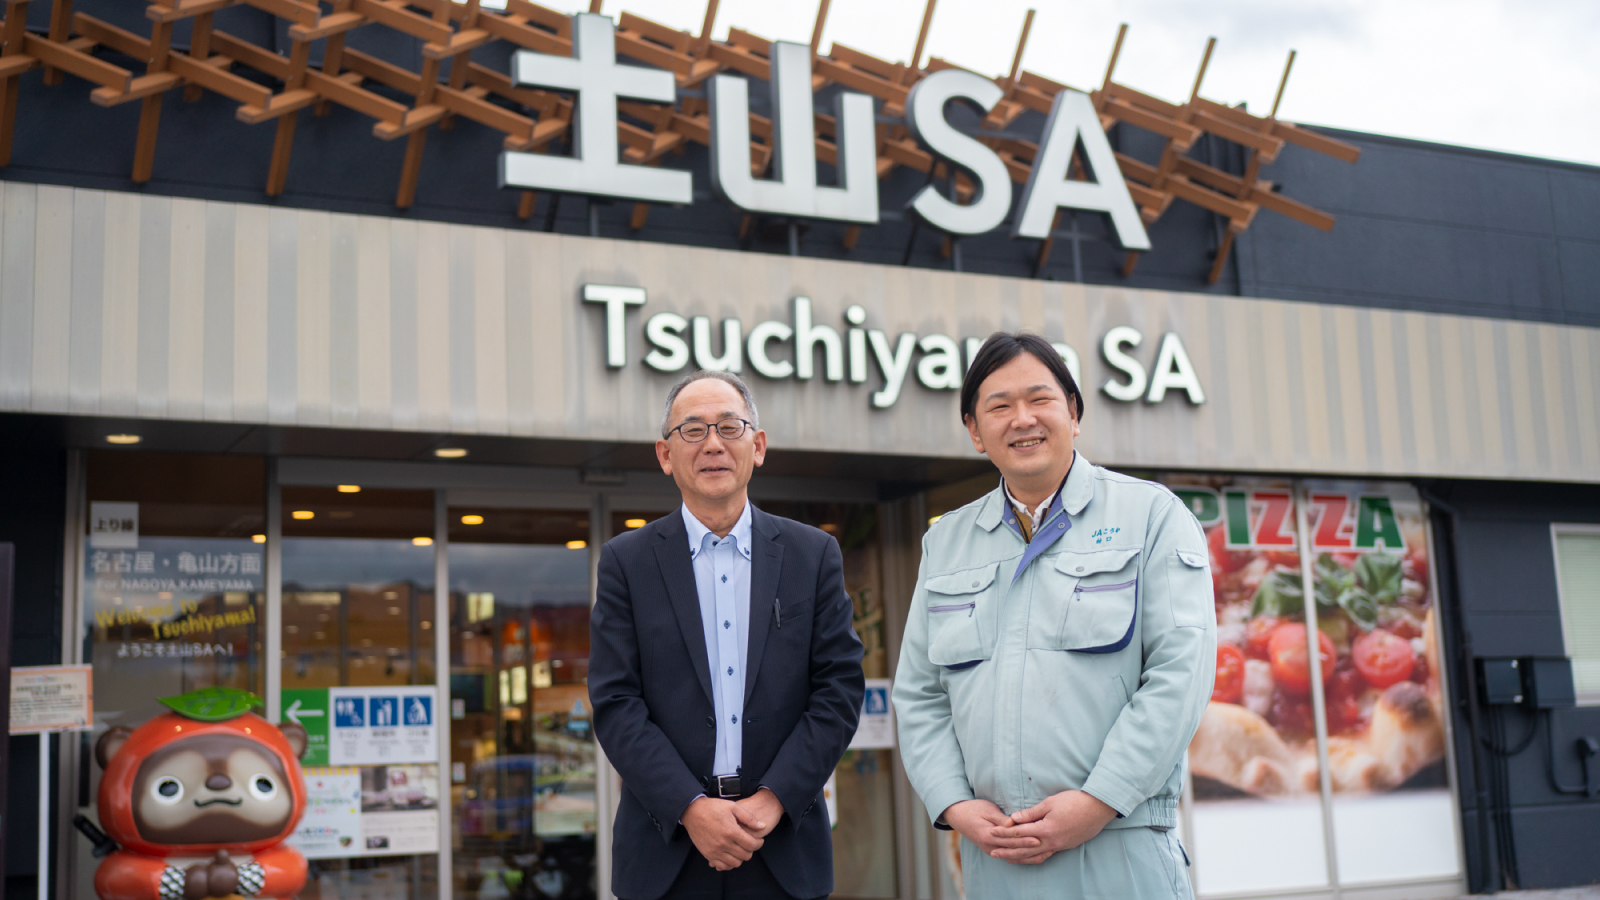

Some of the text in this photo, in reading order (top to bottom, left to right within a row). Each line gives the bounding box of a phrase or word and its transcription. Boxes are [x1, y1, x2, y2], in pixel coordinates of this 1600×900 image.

[1100, 325, 1206, 405] SA
[94, 518, 135, 532] 上り線
[1172, 486, 1407, 552] PIZZA
[91, 551, 261, 575] 名古屋・亀山方面
[94, 599, 198, 629] Welcome to
[152, 604, 256, 640] Tsuchiyama!
